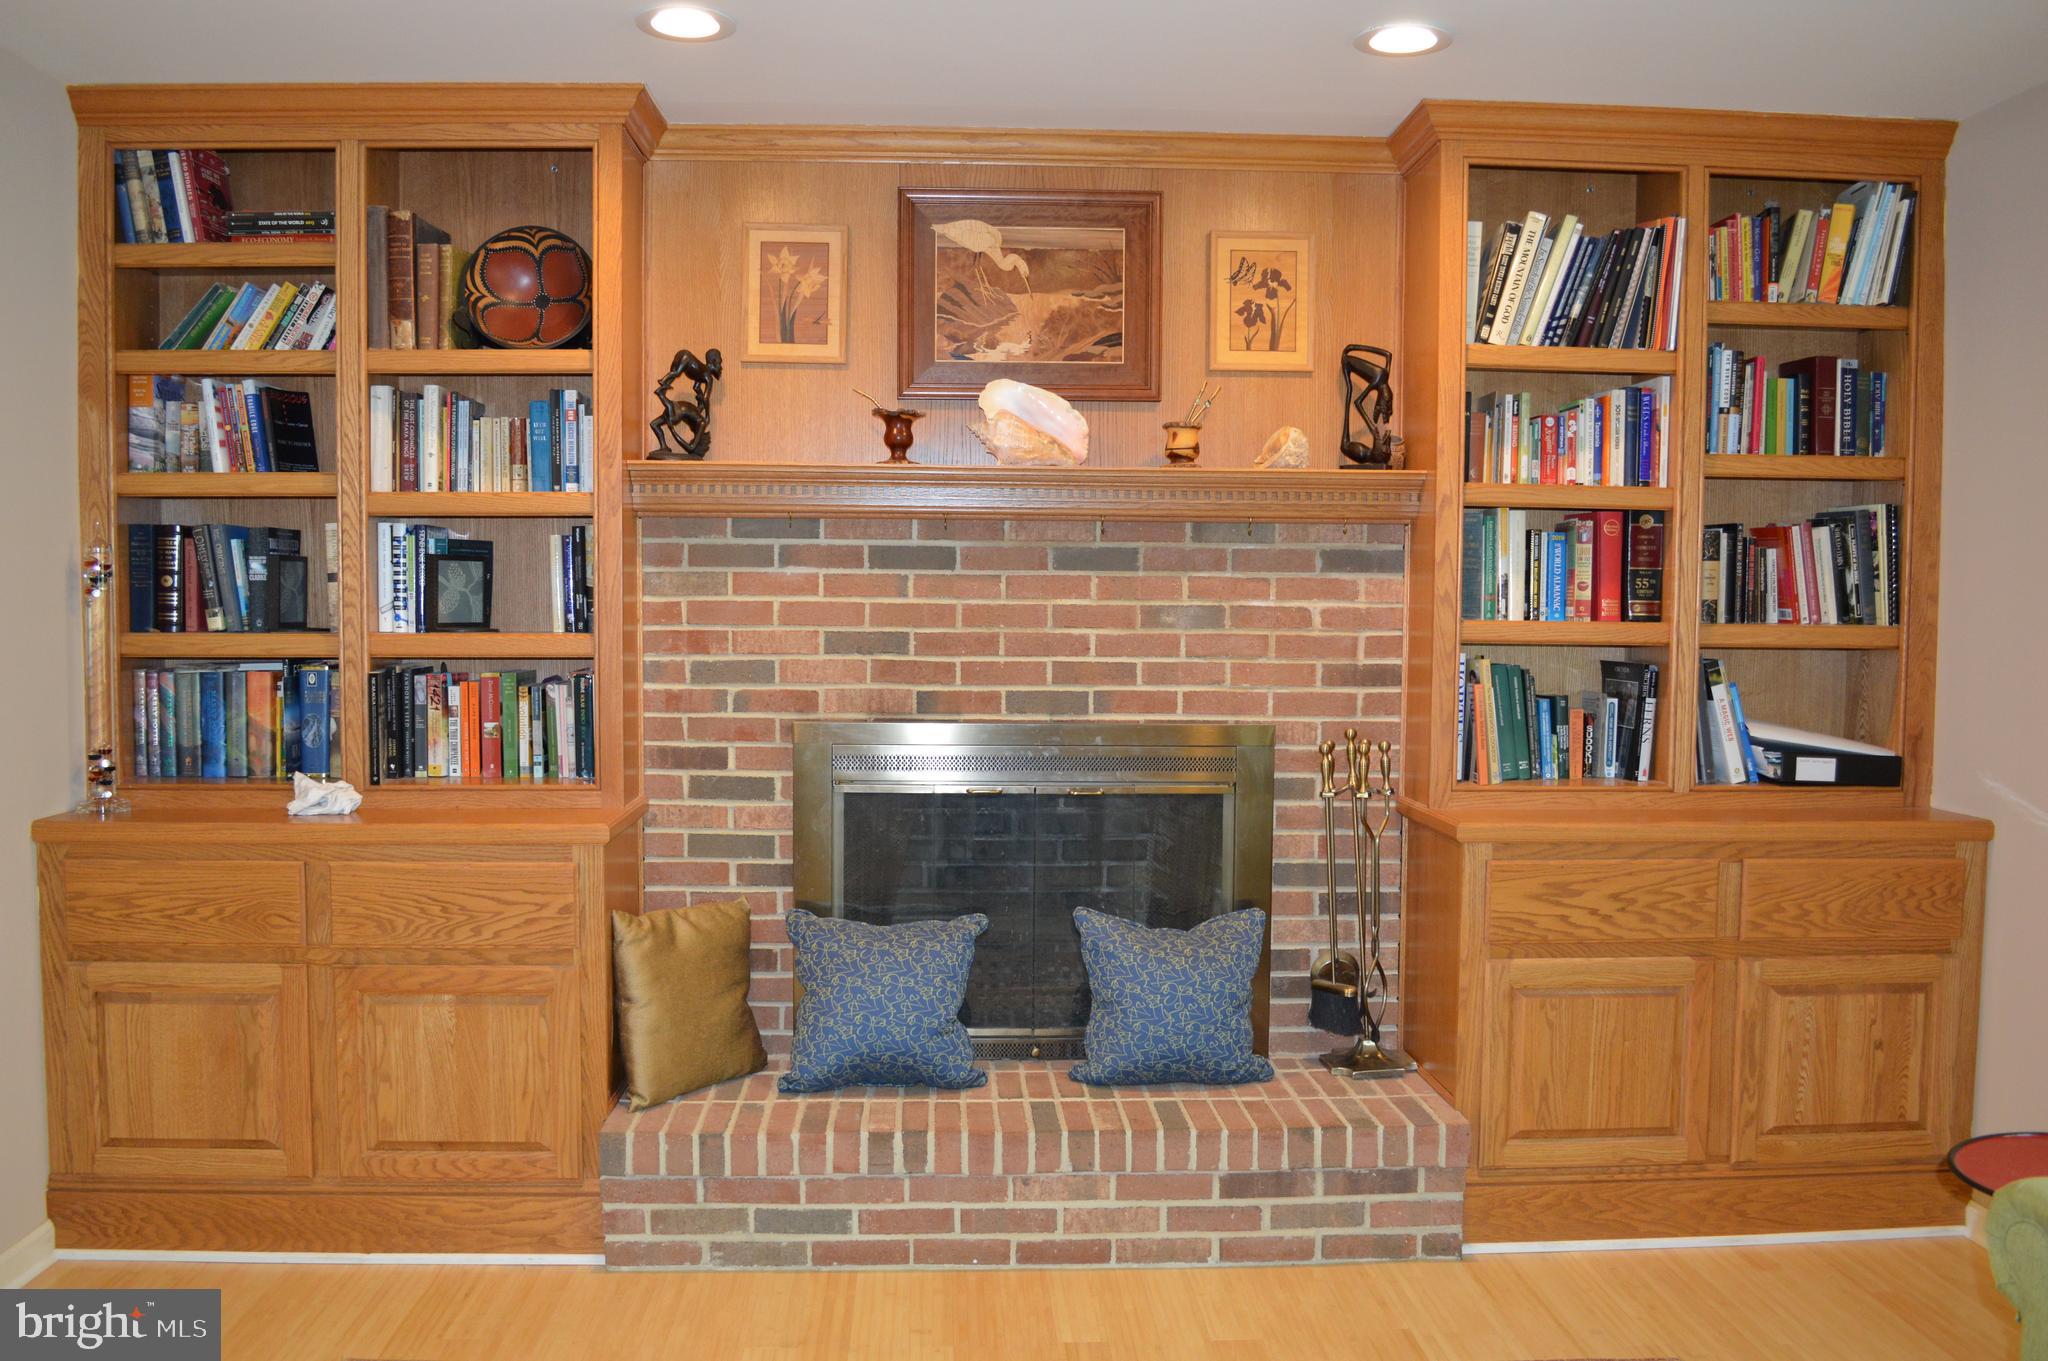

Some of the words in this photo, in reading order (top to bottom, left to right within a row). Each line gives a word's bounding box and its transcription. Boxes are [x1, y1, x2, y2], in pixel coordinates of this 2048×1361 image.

[184, 172, 193, 201] STORIES
[1525, 229, 1536, 247] THE
[1510, 247, 1531, 293] MOUNTAIN
[1507, 292, 1517, 304] OF
[1500, 303, 1513, 325] GOD
[1844, 374, 1852, 404] HOLY
[403, 400, 409, 408] OF
[249, 419, 258, 434] EDGE
[1843, 409, 1851, 443] BIBLE
[1554, 547, 1562, 574] WORLD
[1553, 575, 1561, 611] ALMANAC
[430, 684, 441, 711] 1421
[450, 719, 459, 728] THE
[519, 701, 528, 740] Evolution
[1642, 701, 1654, 743] FERNS
[1720, 704, 1731, 726] MAGIC
[1726, 727, 1734, 742] WEB
[1585, 725, 1593, 765] SUDOKU
